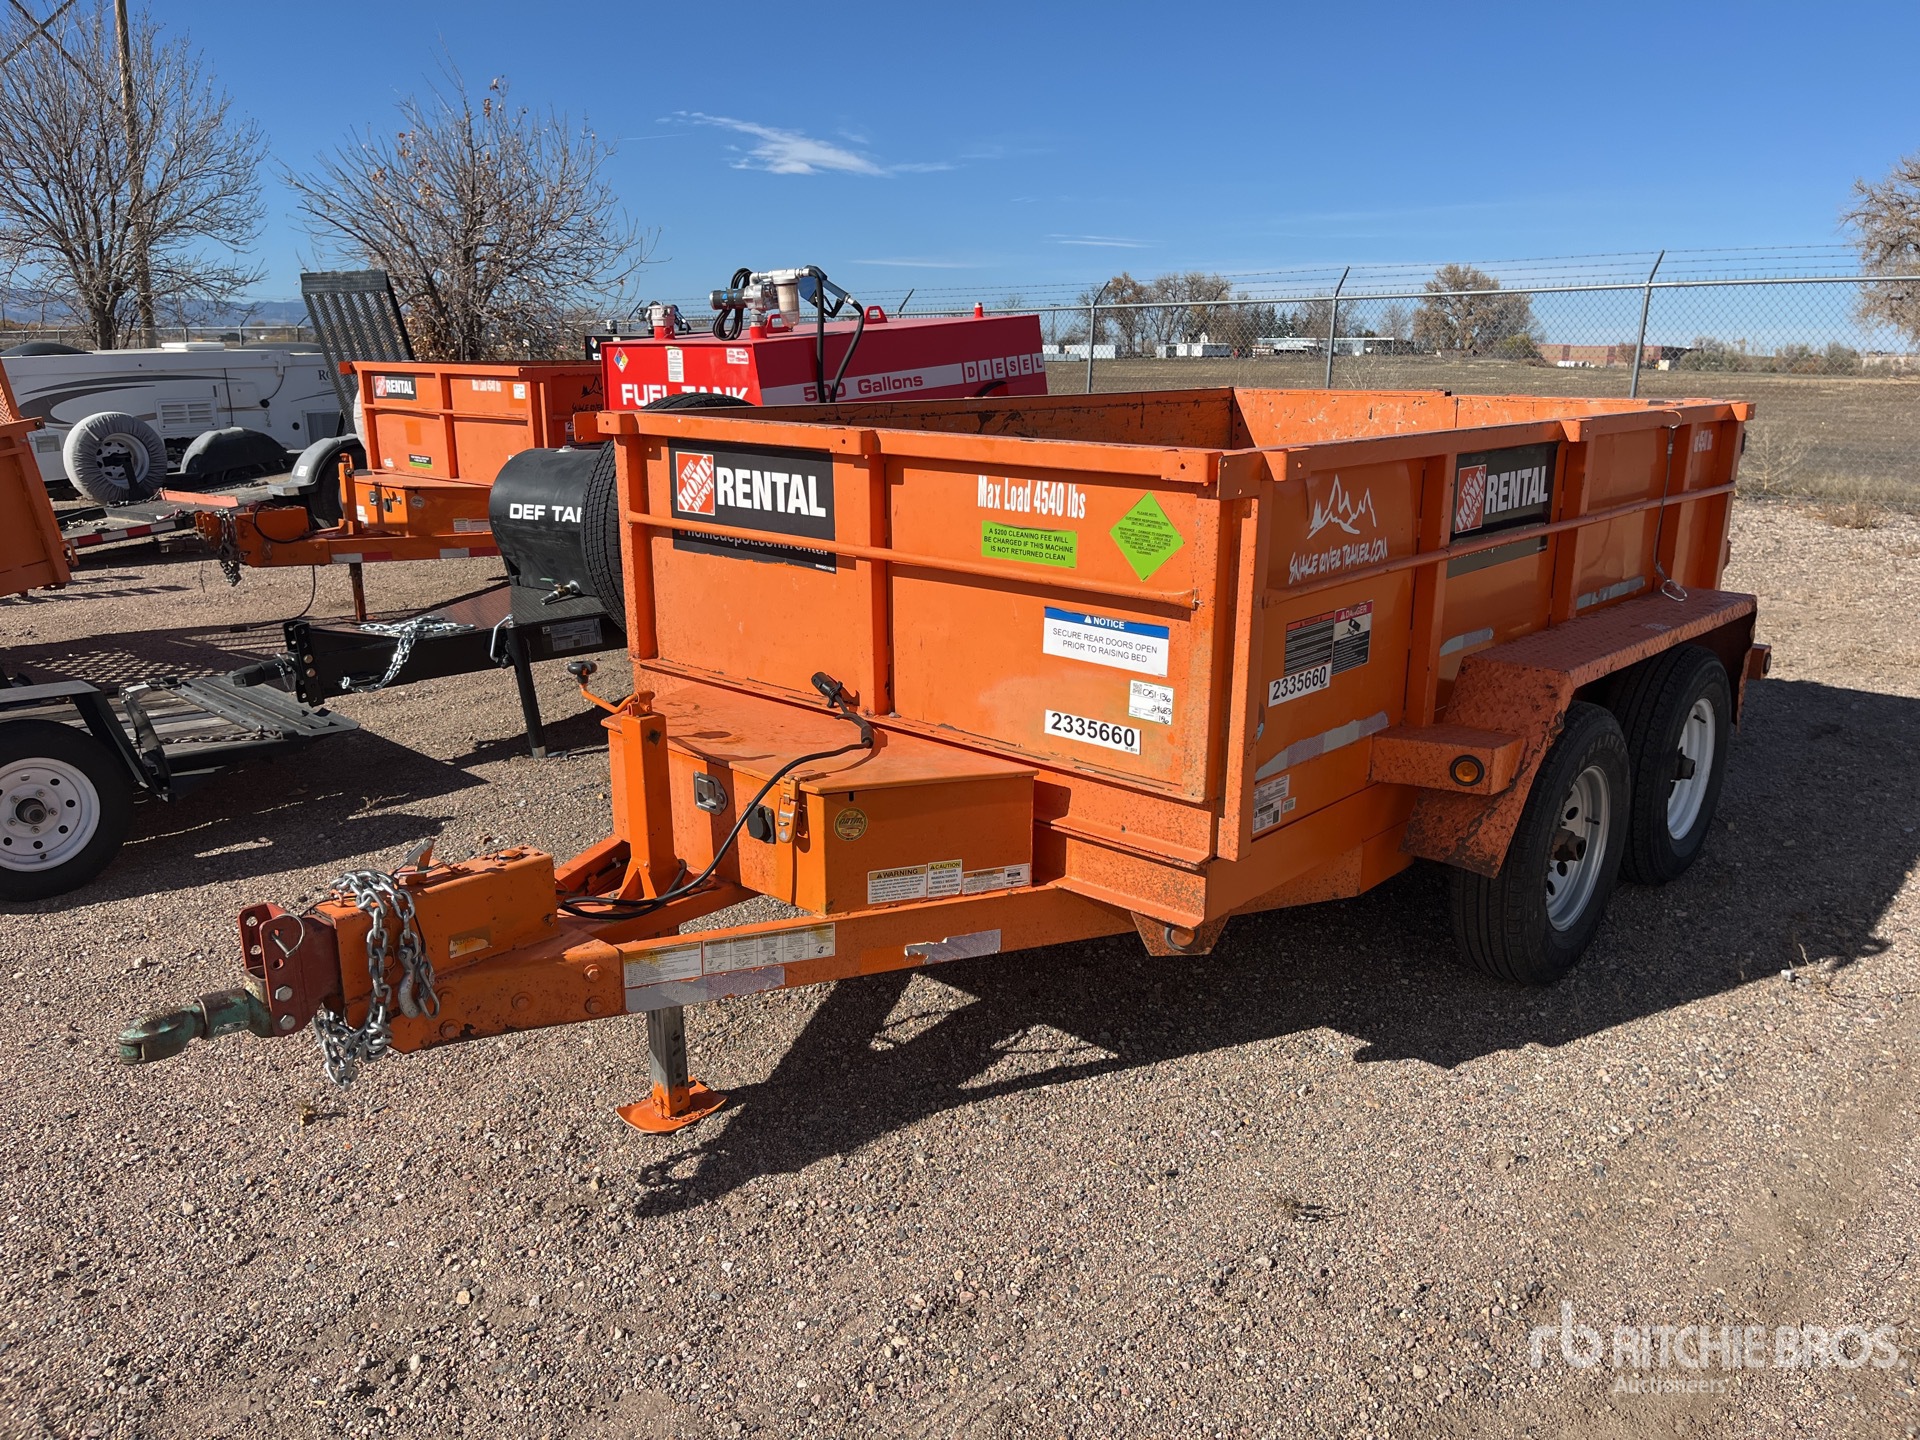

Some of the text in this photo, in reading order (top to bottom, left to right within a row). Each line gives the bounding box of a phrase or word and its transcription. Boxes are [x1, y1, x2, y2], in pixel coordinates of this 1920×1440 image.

[967, 357, 1043, 378] DIESEL
[386, 380, 414, 395] RENTAL
[857, 375, 924, 395] Gallons
[680, 459, 697, 482] THE
[677, 454, 714, 512] HOME
[716, 466, 827, 518] RENTAL
[1484, 465, 1548, 515] RENTAL
[692, 477, 714, 513] DEPOT
[977, 474, 1086, 519] Max Load 4540 lbs
[509, 503, 546, 521] DEF
[993, 537, 1022, 547] CHARGED
[1045, 544, 1074, 553] MACHINE
[994, 528, 1008, 536] $200
[1008, 530, 1039, 540] CLEANING
[1040, 534, 1052, 542] FEE
[1053, 536, 1069, 544] WILL
[1010, 548, 1044, 558] RETURNED
[1044, 552, 1066, 561] CLEAN
[1093, 616, 1125, 630] NOTICE
[1053, 627, 1158, 654] SECURE REAR DOORS OPEN
[1062, 640, 1147, 663] PRIOR TO RAISING BED
[1272, 665, 1327, 701] 2335660
[1051, 712, 1135, 748] 2335660
[882, 868, 918, 879] WARNING
[934, 862, 960, 870] CAUTION
